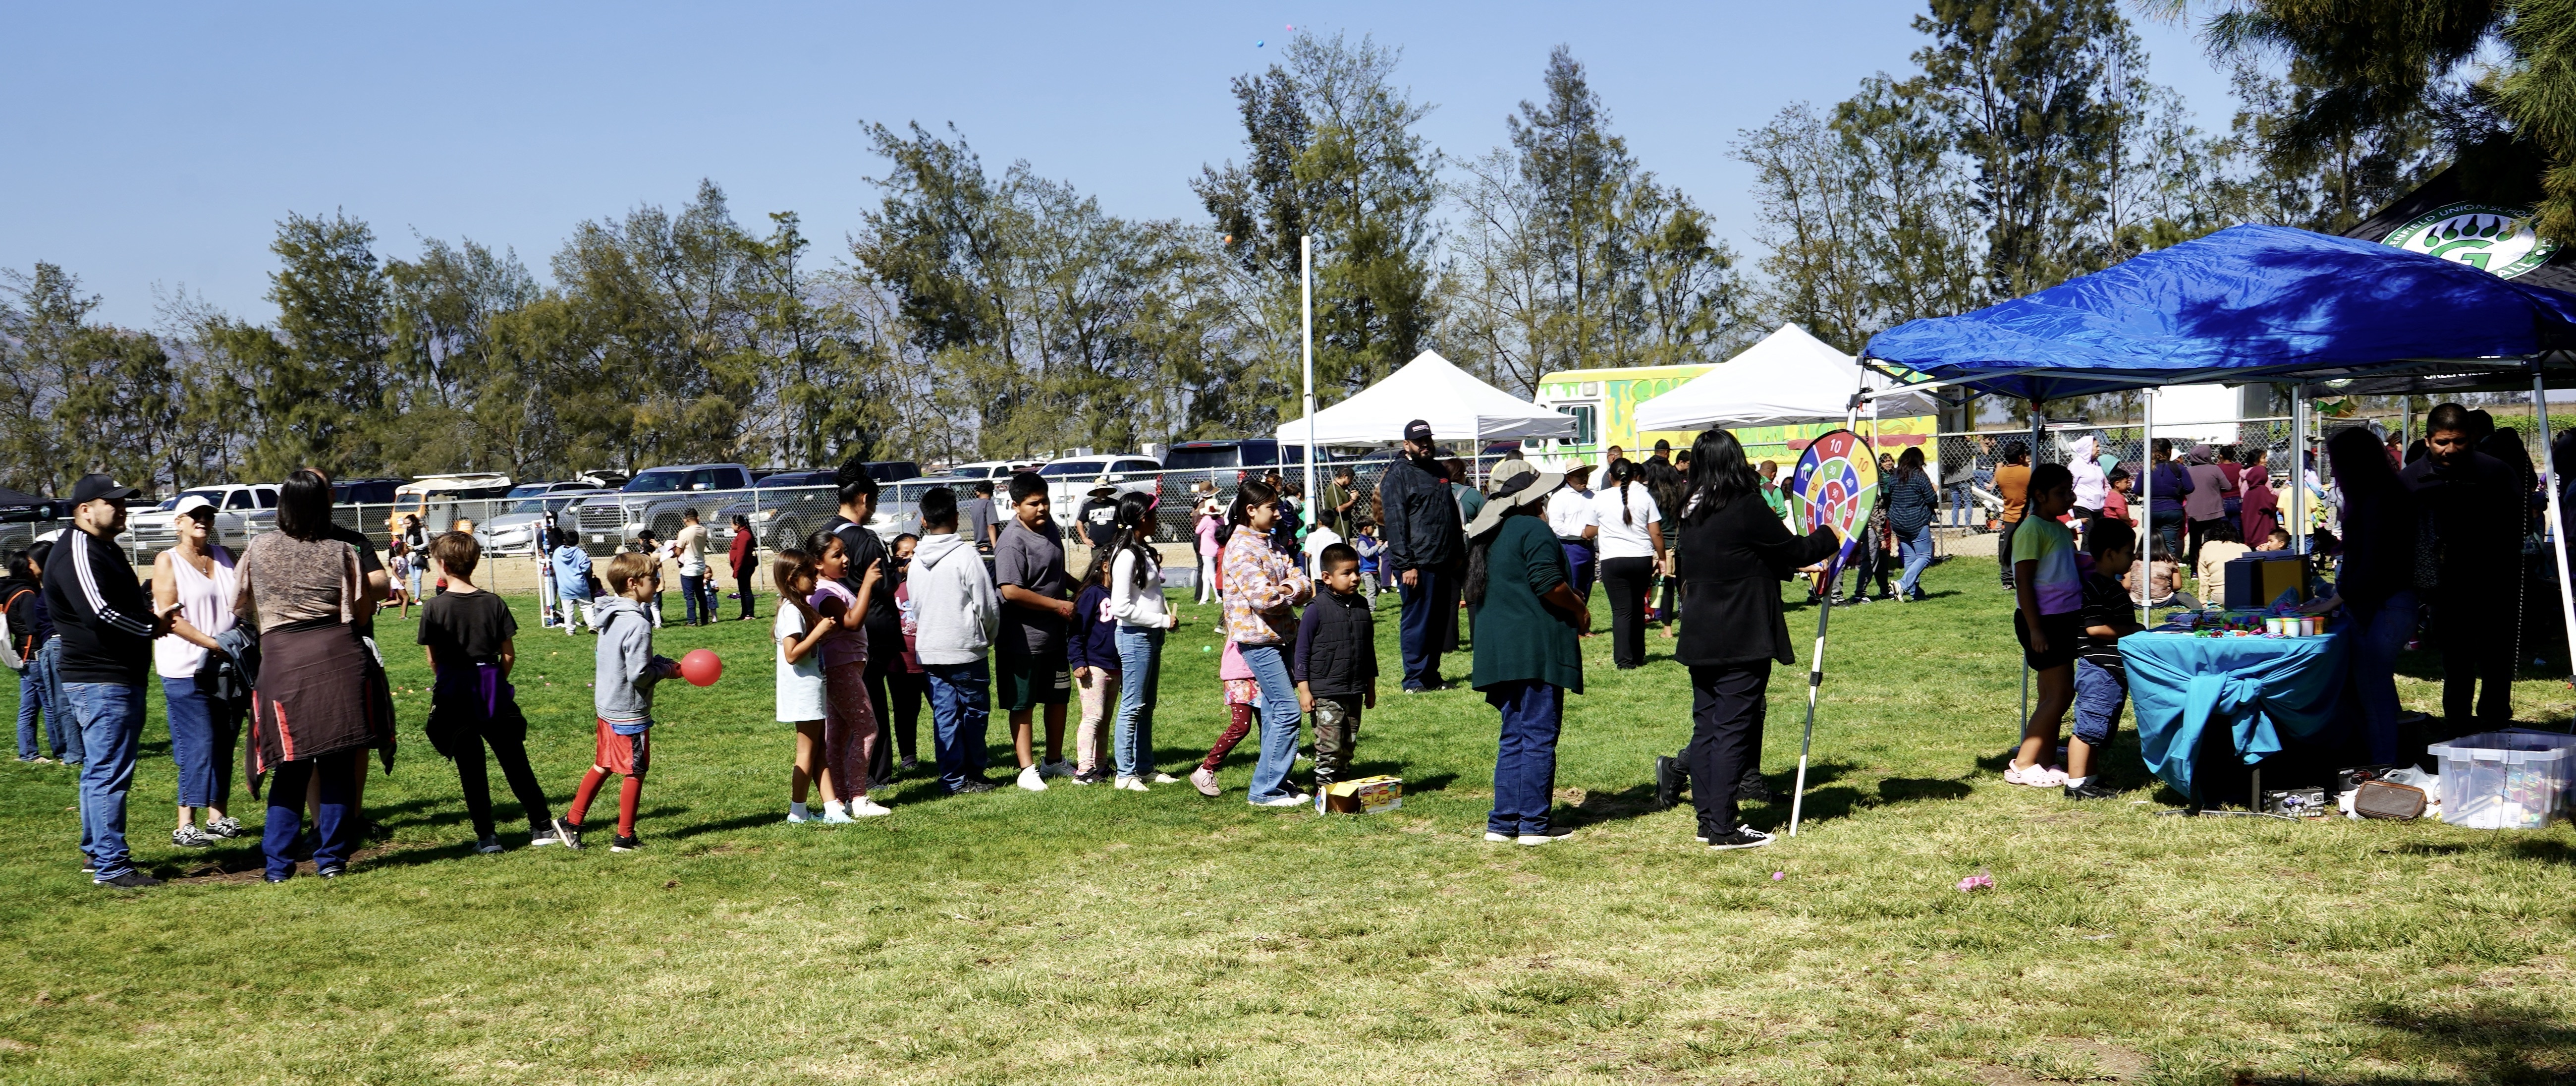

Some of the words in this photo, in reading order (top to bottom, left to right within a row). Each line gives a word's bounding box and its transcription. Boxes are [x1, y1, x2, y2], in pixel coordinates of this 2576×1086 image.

[2439, 204, 2486, 217] UNION
[2497, 262, 2535, 278] ALL
[1830, 438, 1842, 454] 10
[1828, 465, 1837, 475] 30
[1858, 457, 1869, 472] 10
[1800, 467, 1810, 482] 10
[1811, 482, 1818, 492] 20
[1846, 478, 1854, 488] 40
[1832, 488, 1839, 498] 90
[1816, 503, 1823, 513] 80
[1846, 509, 1854, 518] 50
[1808, 515, 1813, 524] 30
[1857, 507, 1869, 521] 10
[1797, 514, 1805, 529] 10
